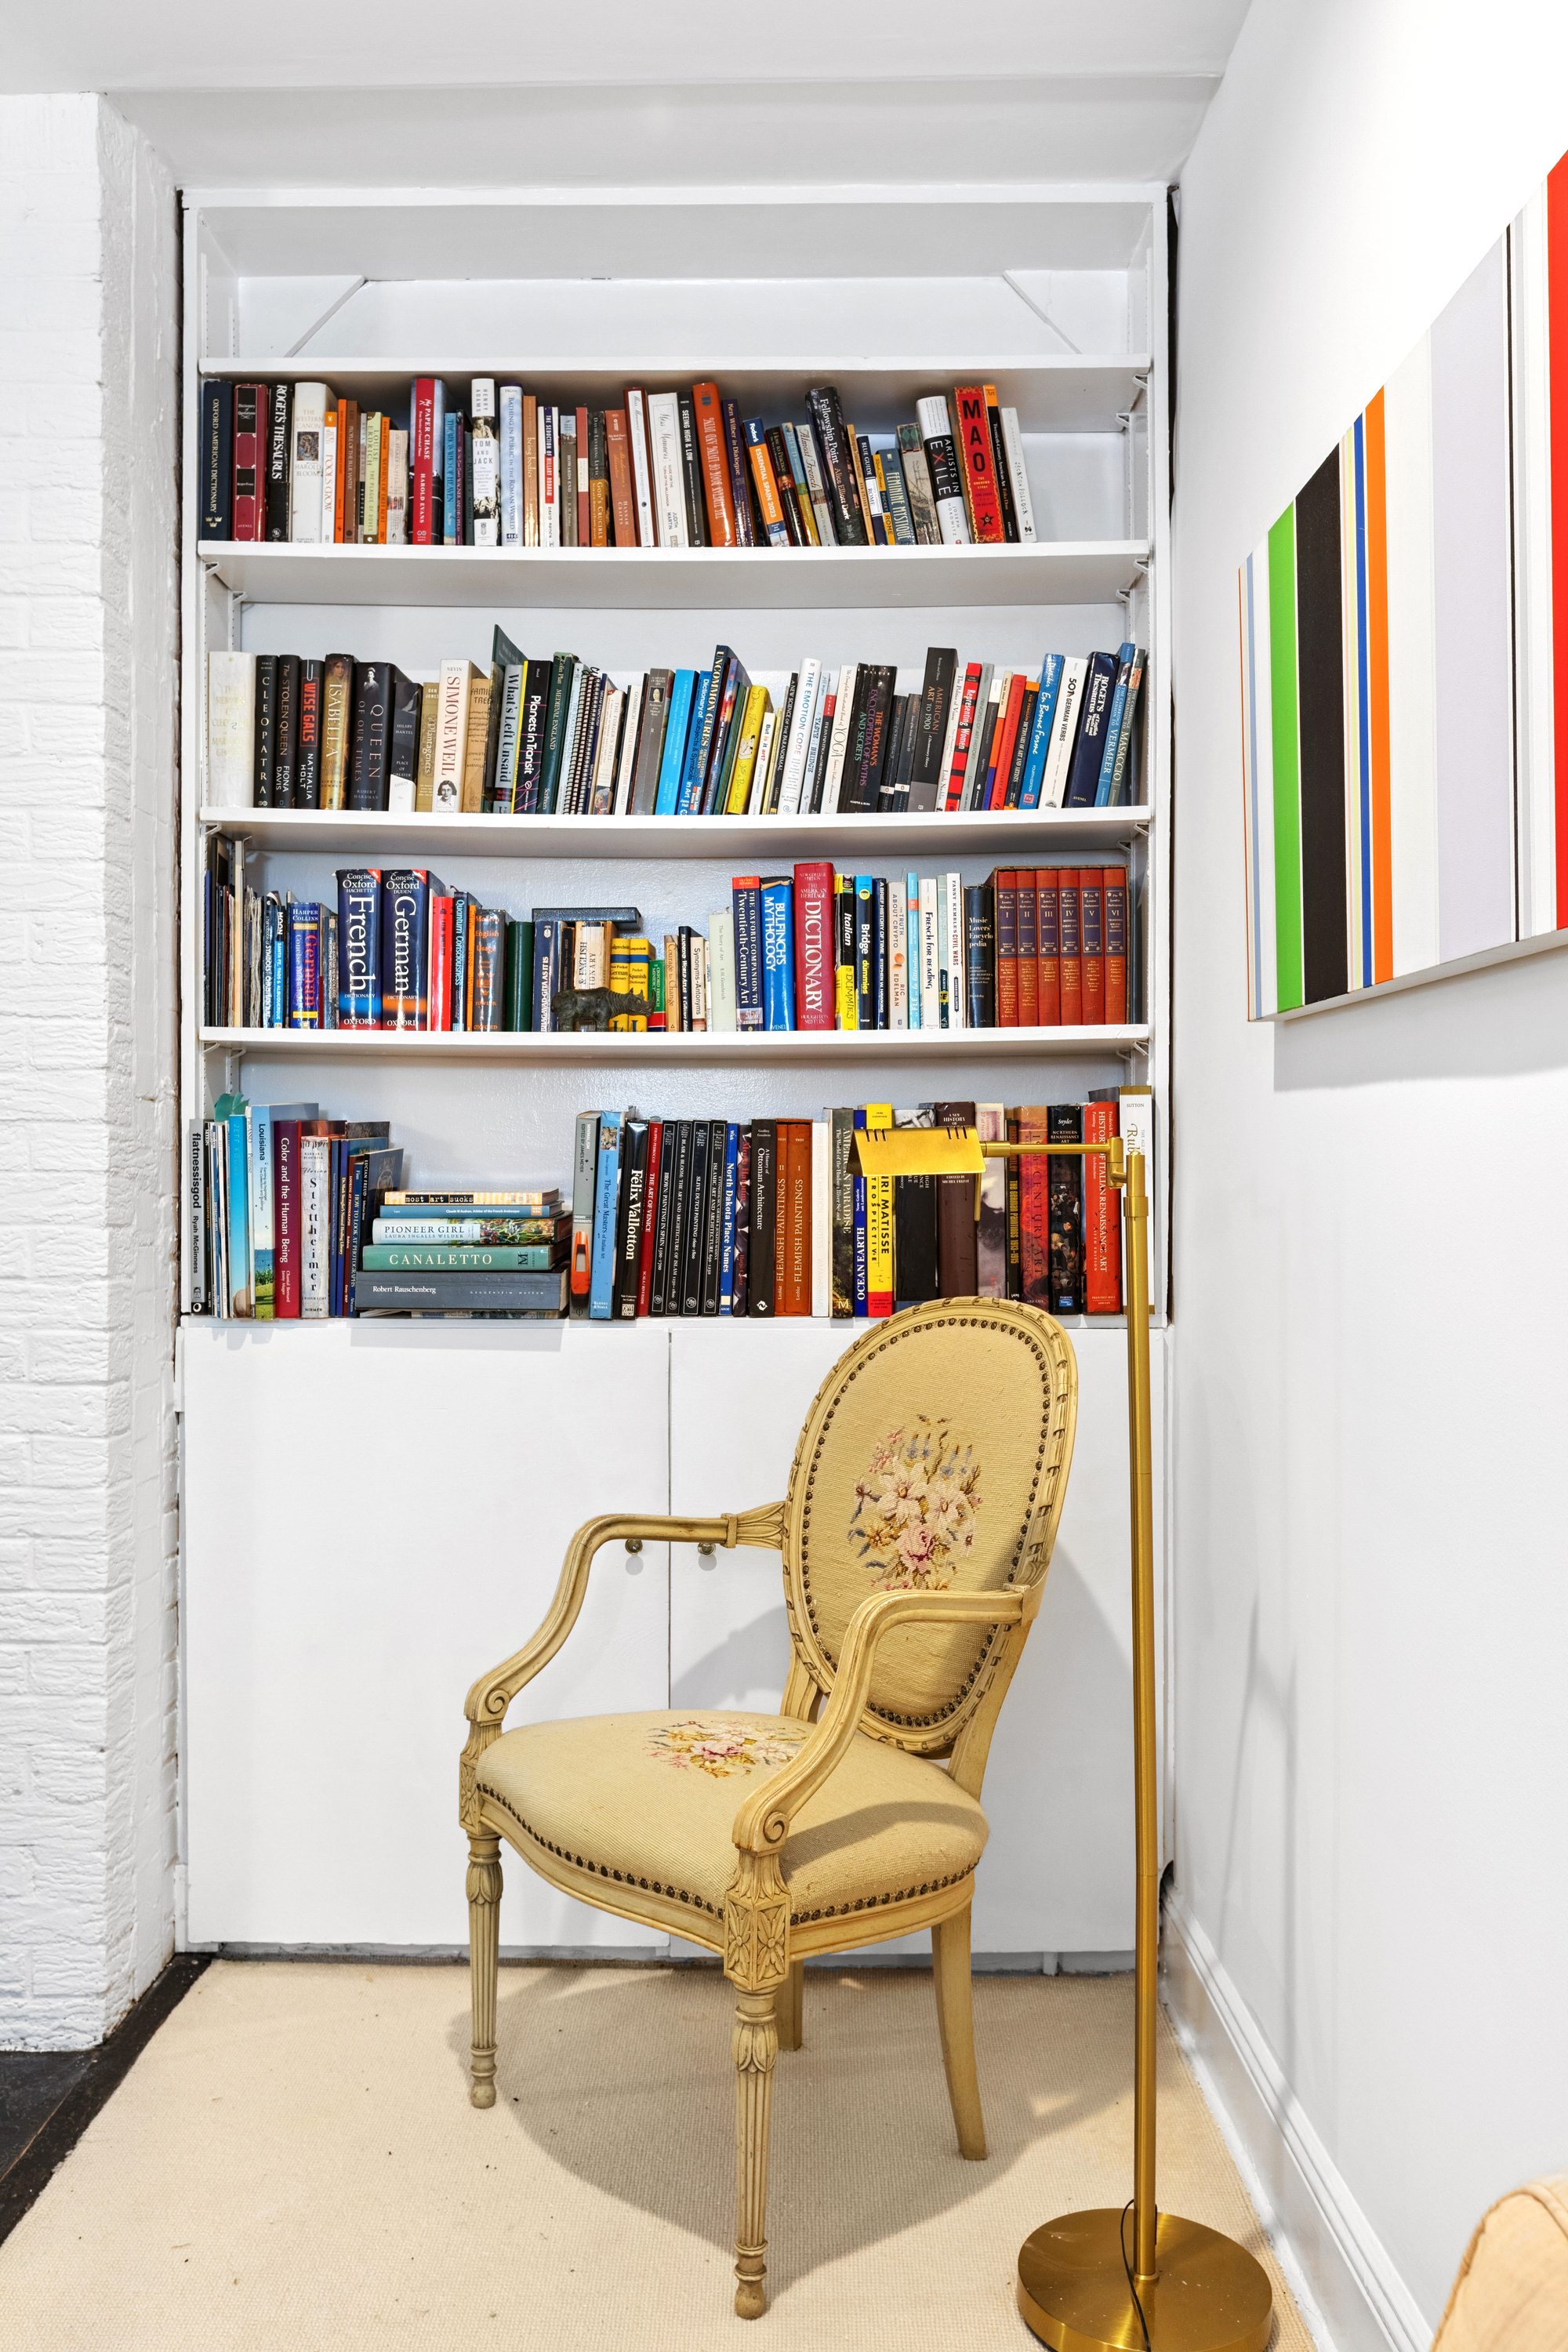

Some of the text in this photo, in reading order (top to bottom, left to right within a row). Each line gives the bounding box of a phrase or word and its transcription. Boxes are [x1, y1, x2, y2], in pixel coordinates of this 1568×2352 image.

[272, 385, 287, 479] ROGET'S THESAURUS
[525, 437, 535, 455] being
[732, 447, 741, 475] Dialogue
[820, 398, 840, 463] Fellowship Point
[963, 399, 985, 472] MAO
[755, 448, 766, 481] ESSENTIAL
[768, 502, 776, 517] 2023
[930, 441, 951, 495] EXILE
[944, 439, 960, 492] ARTISTS IN
[260, 677, 270, 793] CLEOPATRA
[303, 683, 315, 741] WISE GALS
[326, 684, 342, 757] ISABELLA
[358, 701, 365, 713] OF
[441, 677, 460, 775] SIMONE WEIL
[500, 674, 519, 782] What's Left Unsaid
[524, 695, 541, 774] Planets in Transit
[550, 689, 561, 750] MEDIEVAL ENGLAND
[794, 672, 814, 755] THE EMOTION CODE
[958, 689, 975, 749] Representing Women
[1033, 692, 1050, 754] En Bonne Forme
[1059, 678, 1076, 741] 501 GERMAN VERBS
[354, 749, 363, 781] TIMES
[368, 705, 383, 778] QUEEN
[831, 728, 847, 757] YOGA
[1103, 729, 1117, 774] VERMEER
[1112, 731, 1129, 781] MASACCIO
[349, 895, 376, 993] French
[395, 896, 416, 993] German
[456, 900, 464, 985] Quantum Consciousness
[738, 891, 750, 1004] Twentieth-Century Art
[764, 897, 775, 971] MYTHOLOGY
[775, 903, 786, 964] BULFINCH'S
[805, 901, 821, 1013] DICTIONARY
[859, 924, 870, 954] Bridge
[304, 934, 317, 1007] German
[753, 994, 757, 1004] TO
[192, 1133, 202, 1208] flatnessisgod
[281, 1138, 289, 1162] Color
[725, 1163, 734, 1187] North
[626, 1169, 643, 1260] Félix Vallotton
[280, 1239, 289, 1263] Being
[390, 1254, 492, 1265] CANALETTO
[794, 1238, 803, 1282] FLEMISH
[394, 1286, 436, 1294] Rauschenberg
